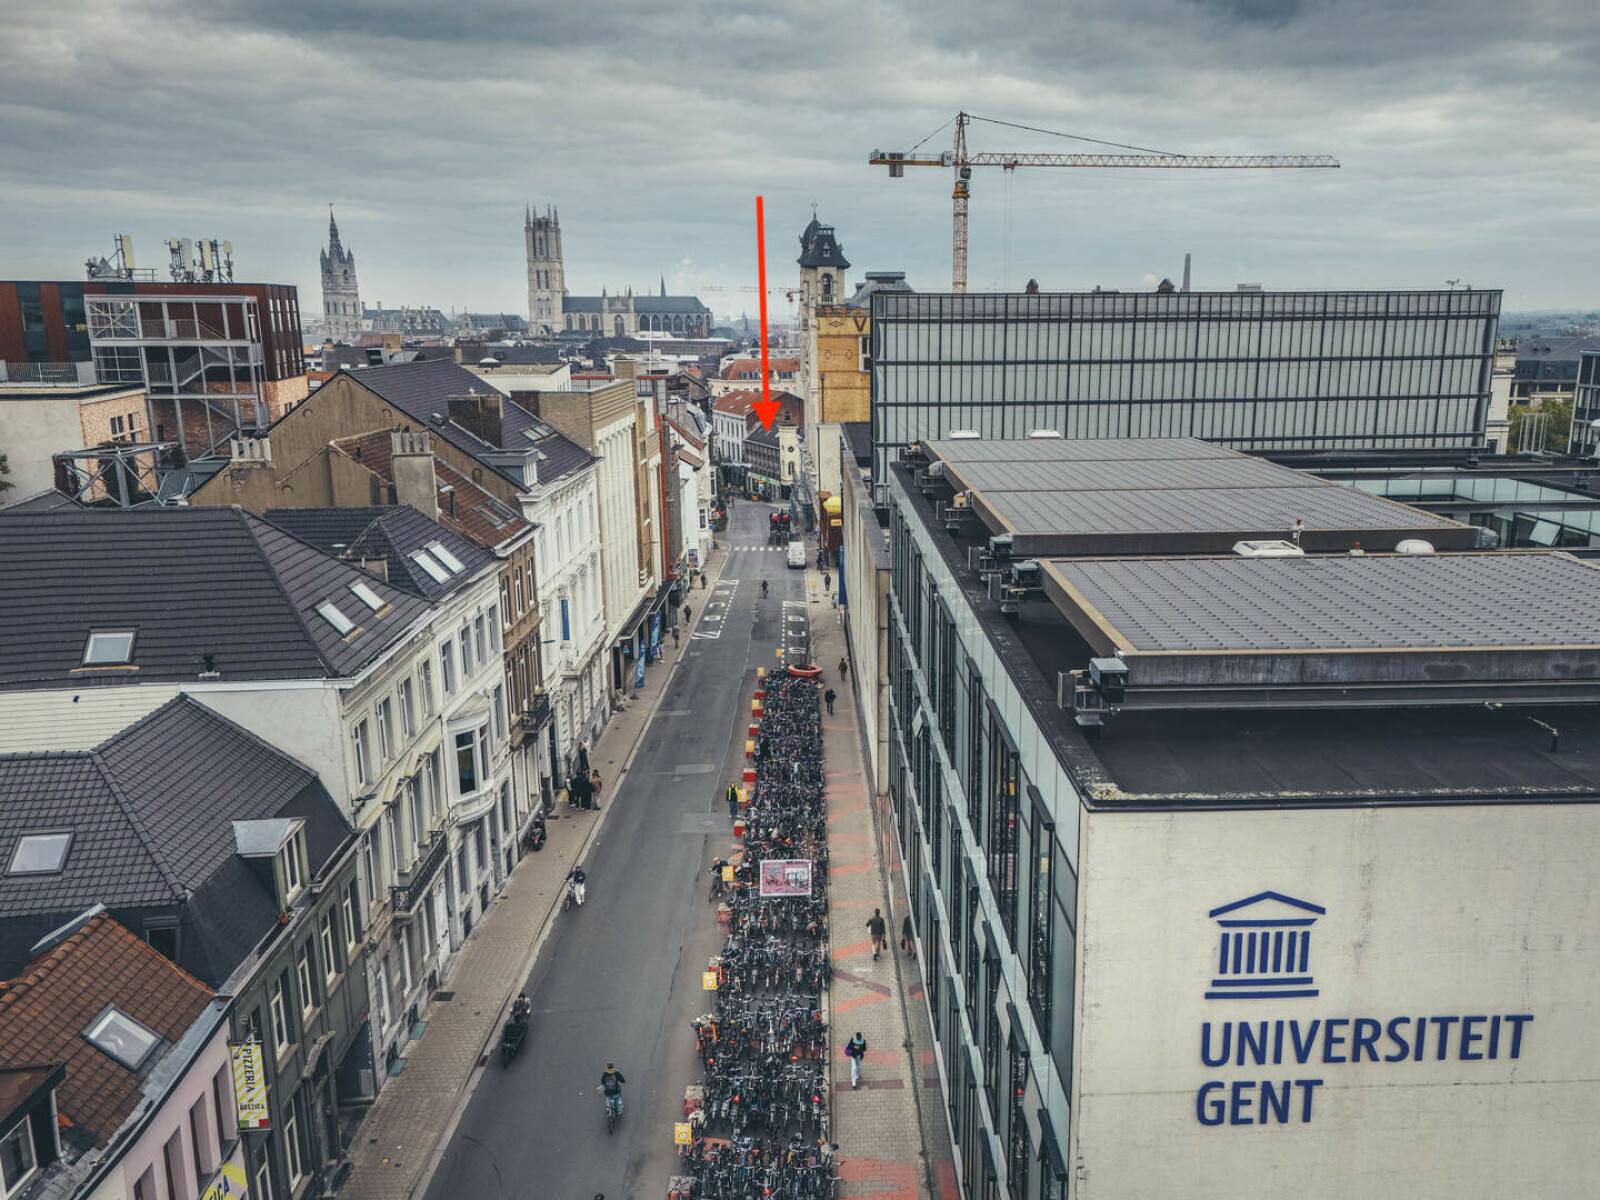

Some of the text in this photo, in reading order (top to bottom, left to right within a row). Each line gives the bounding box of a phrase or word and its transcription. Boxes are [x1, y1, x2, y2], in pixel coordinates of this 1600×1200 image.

[1201, 1014, 1534, 1067] UNIVERSITEIT
[242, 1048, 256, 1093] PIZZERIA
[1196, 1079, 1324, 1126] GENT
